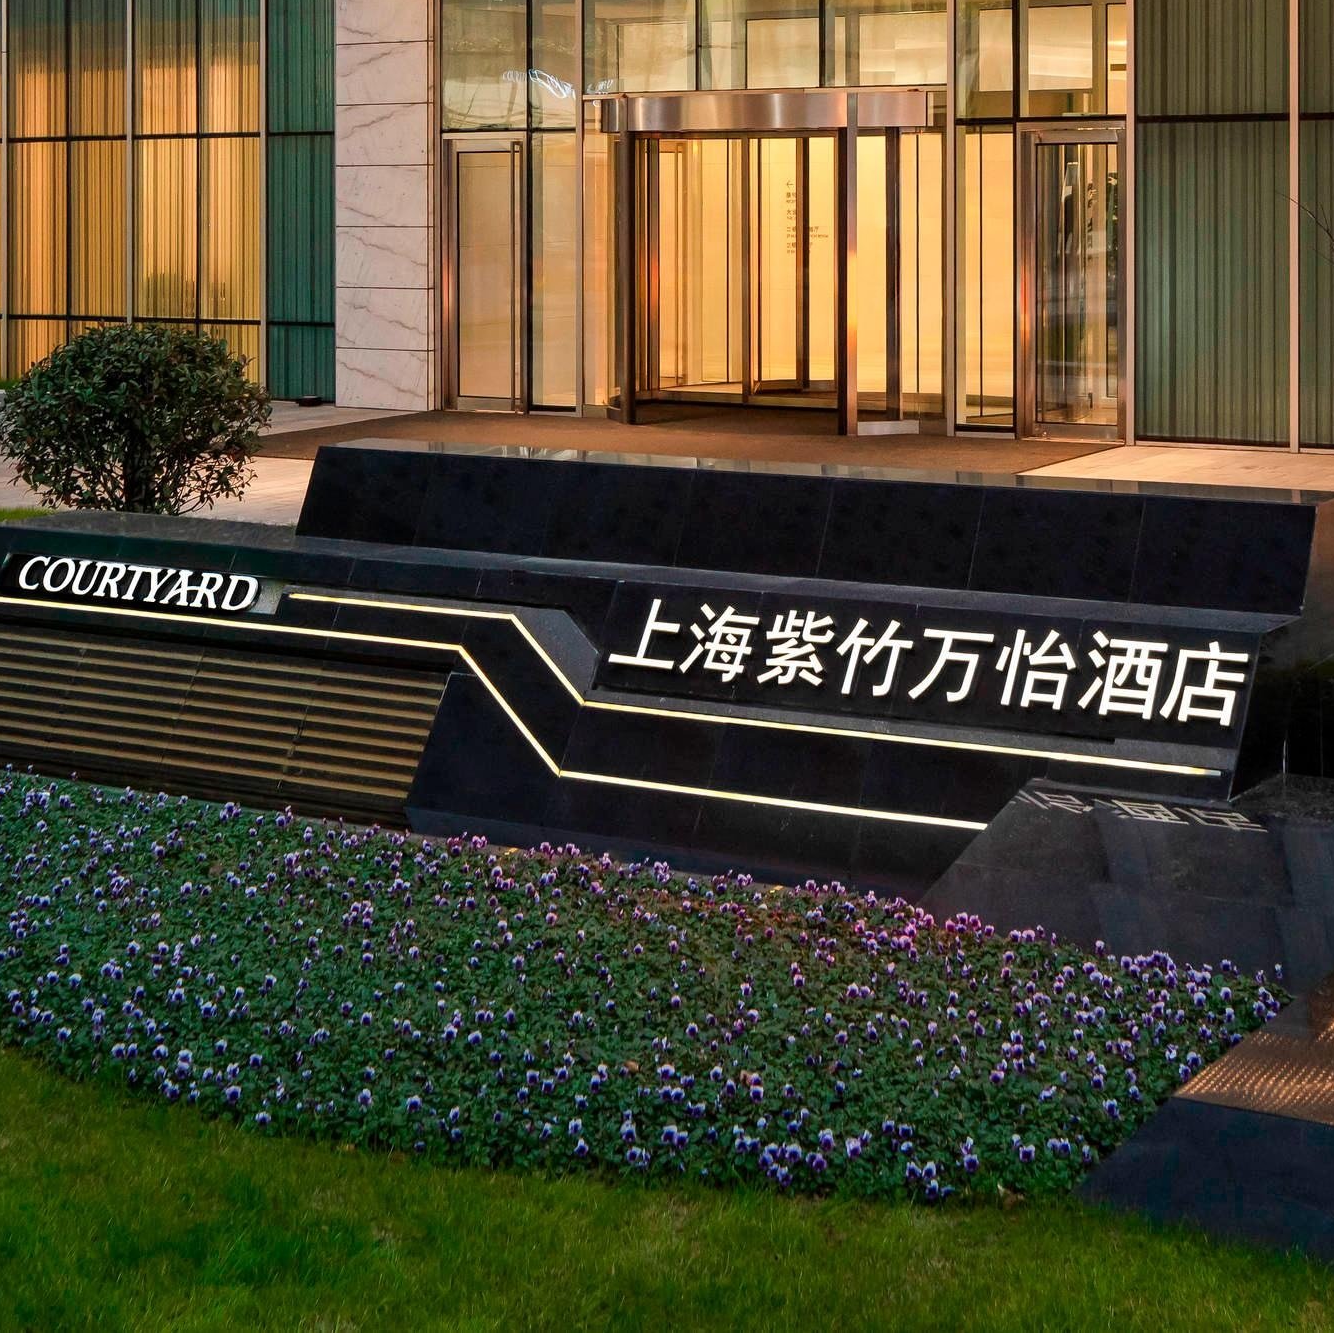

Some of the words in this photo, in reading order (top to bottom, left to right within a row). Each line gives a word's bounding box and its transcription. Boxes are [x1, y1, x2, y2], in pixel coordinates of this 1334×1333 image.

[18, 555, 259, 611] COURTYARD
[608, 598, 1249, 727] 上海紫竹万怡酒店
